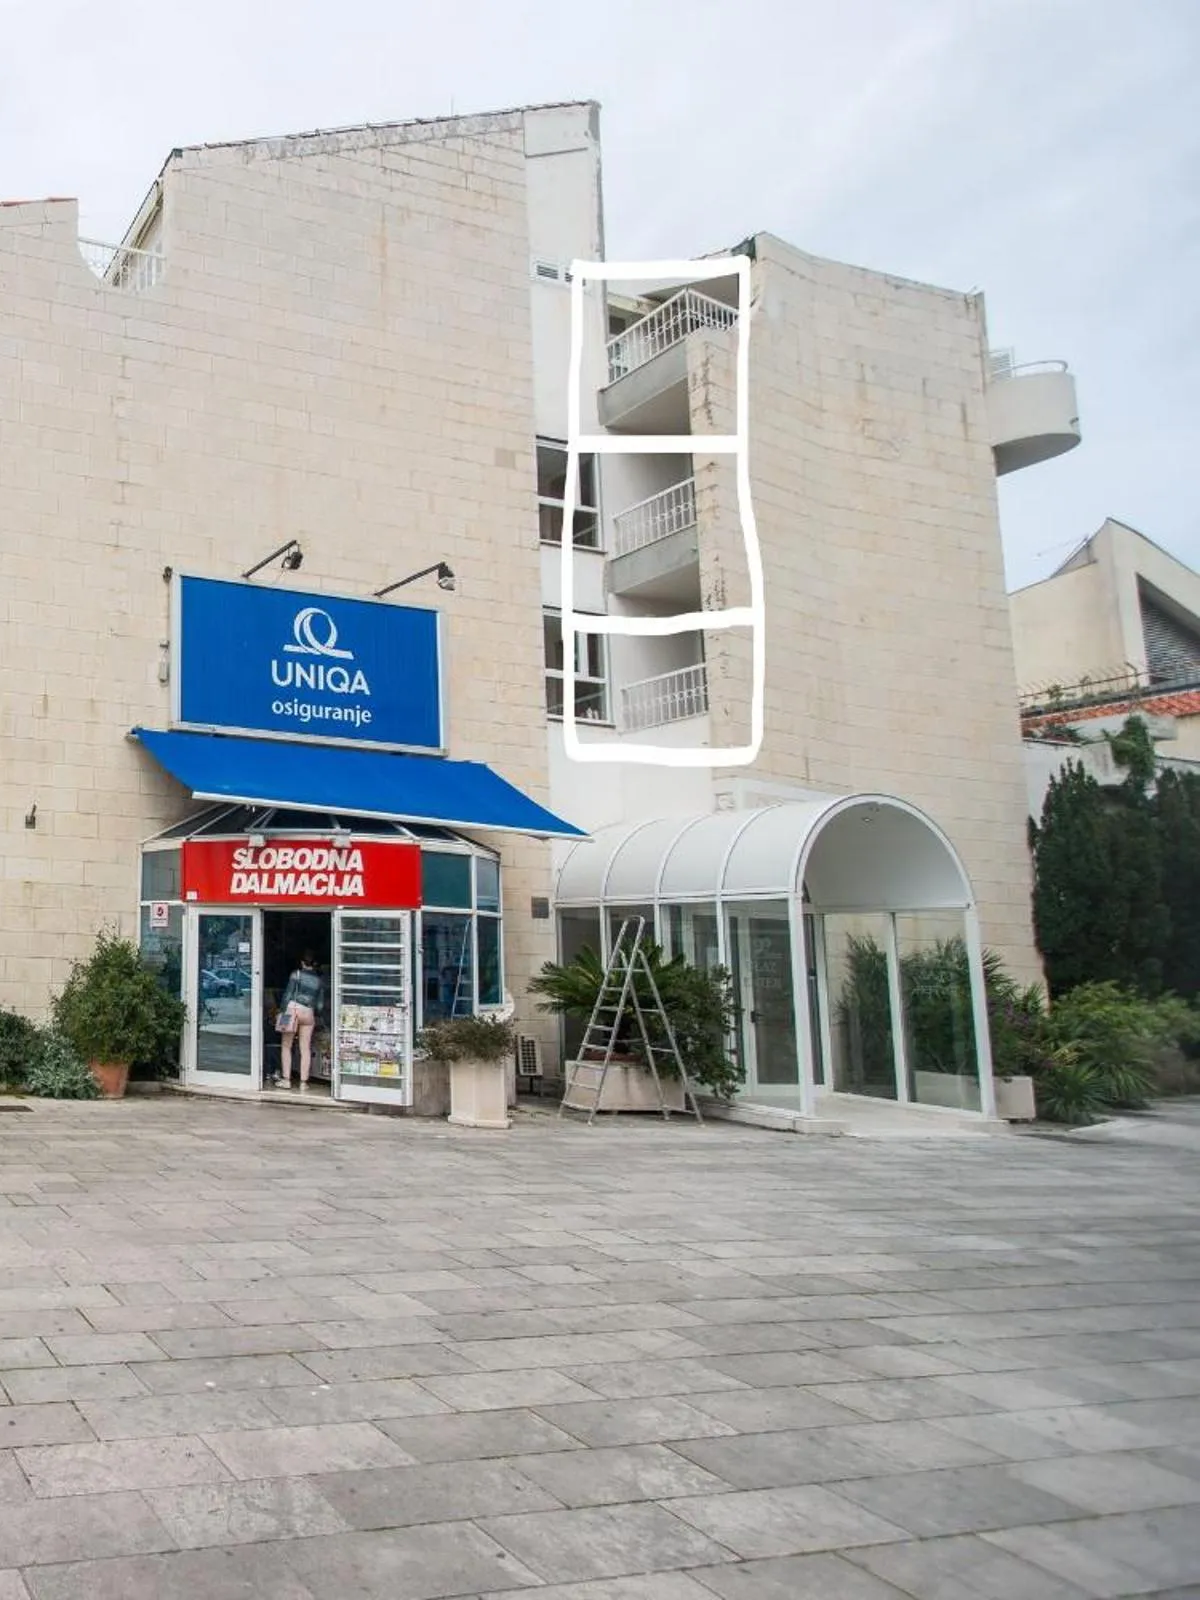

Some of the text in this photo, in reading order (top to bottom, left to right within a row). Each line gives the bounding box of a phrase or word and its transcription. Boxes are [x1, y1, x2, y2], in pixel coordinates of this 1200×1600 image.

[271, 660, 370, 696] UNIQA
[272, 699, 372, 727] osiguranje
[232, 847, 364, 871] SLOBODNA
[230, 872, 365, 897] DALMACIJA
